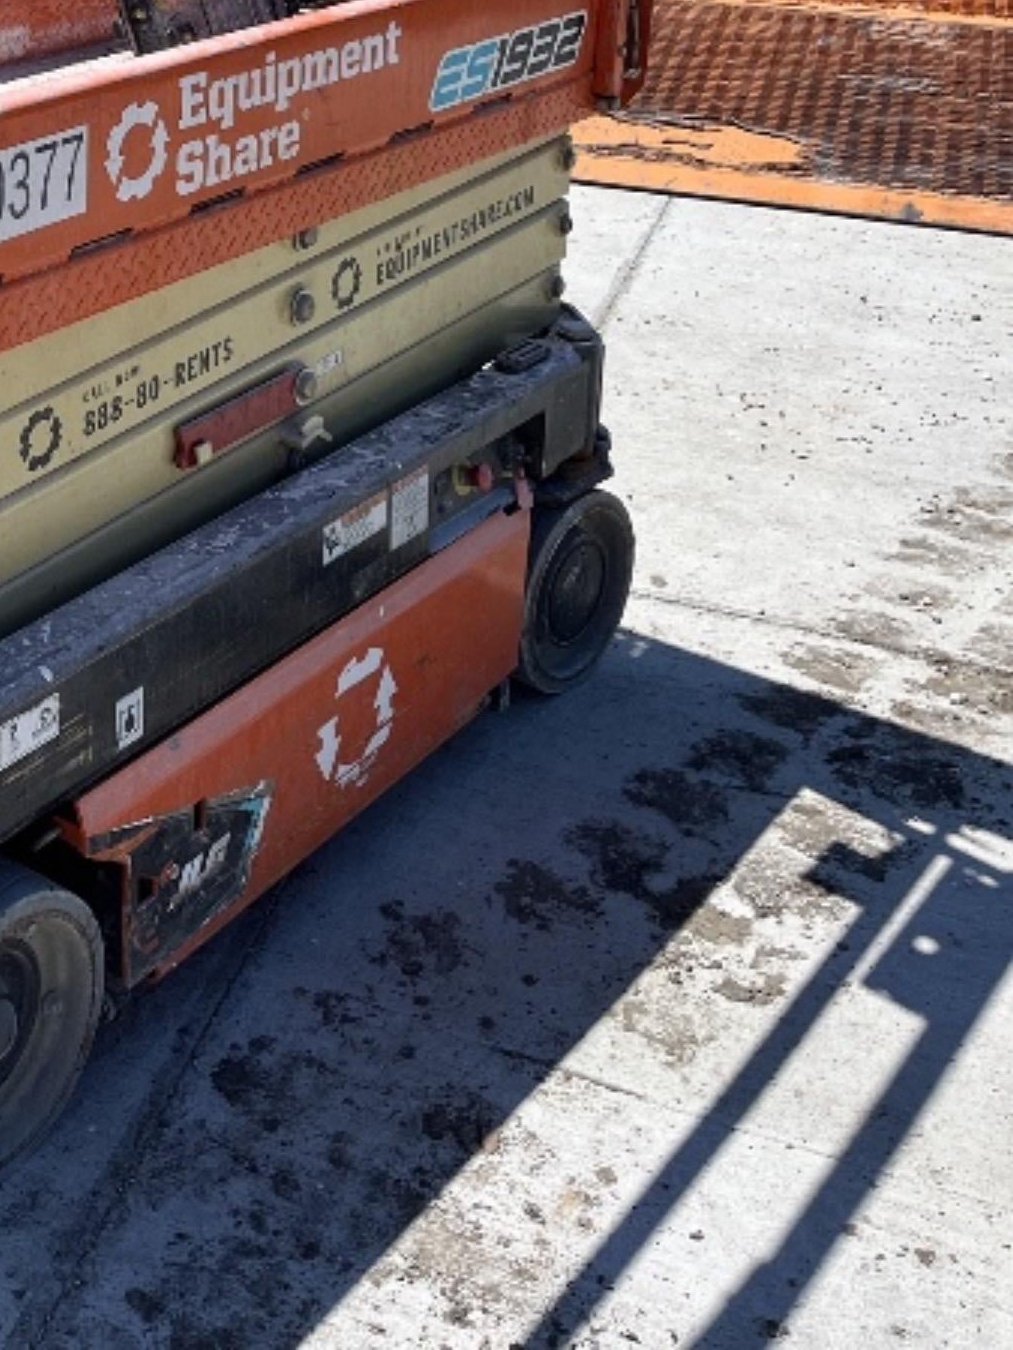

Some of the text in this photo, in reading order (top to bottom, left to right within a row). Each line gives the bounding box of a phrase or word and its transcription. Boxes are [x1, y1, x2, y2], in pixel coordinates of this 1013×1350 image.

[178, 20, 402, 130] Equipment
[428, 10, 587, 111] ES1932
[175, 120, 300, 195] Share
